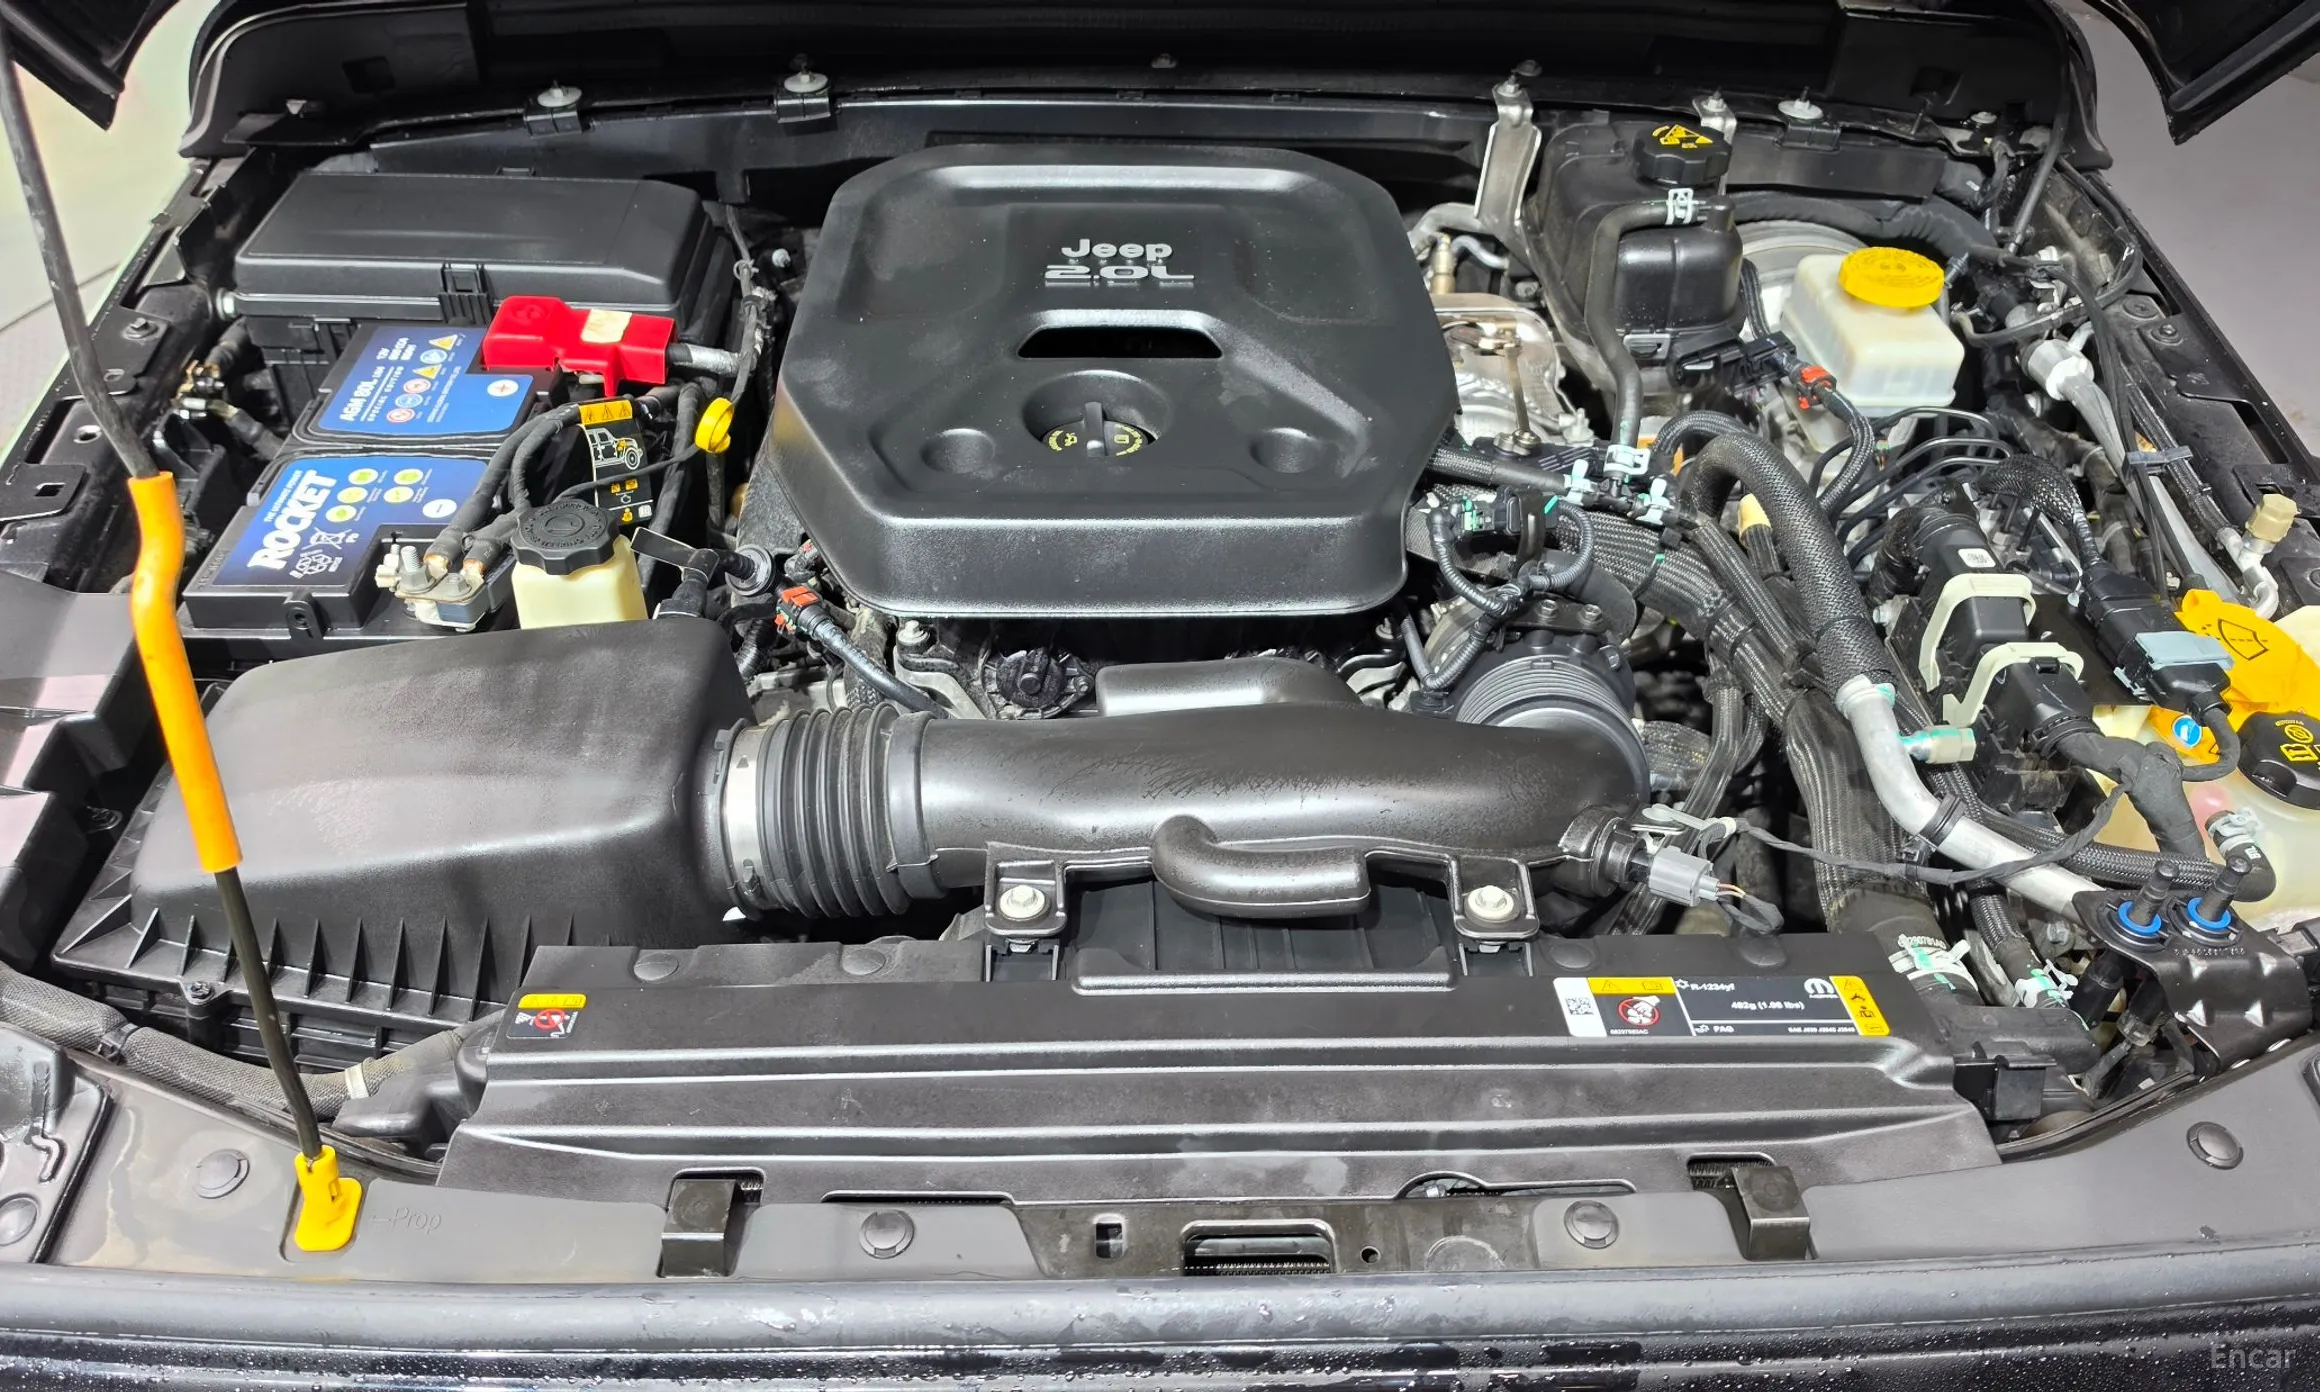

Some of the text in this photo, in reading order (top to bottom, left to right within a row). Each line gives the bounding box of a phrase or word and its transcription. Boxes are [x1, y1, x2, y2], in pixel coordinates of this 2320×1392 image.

[1061, 239, 1173, 261] Jeep
[1045, 265, 1195, 280] 2.0L
[339, 398, 367, 422] AGM
[354, 376, 377, 400] 80L
[367, 366, 405, 422] SPECIAL EDITION
[263, 469, 303, 522] THE ULTIMATE POWER
[247, 469, 337, 570] ROCKET
[1690, 982, 1736, 992] R-1234yf
[1783, 1001, 1806, 1010] lbs)
[1713, 1025, 1735, 1033] PAG
[392, 1207, 442, 1234] Prop
